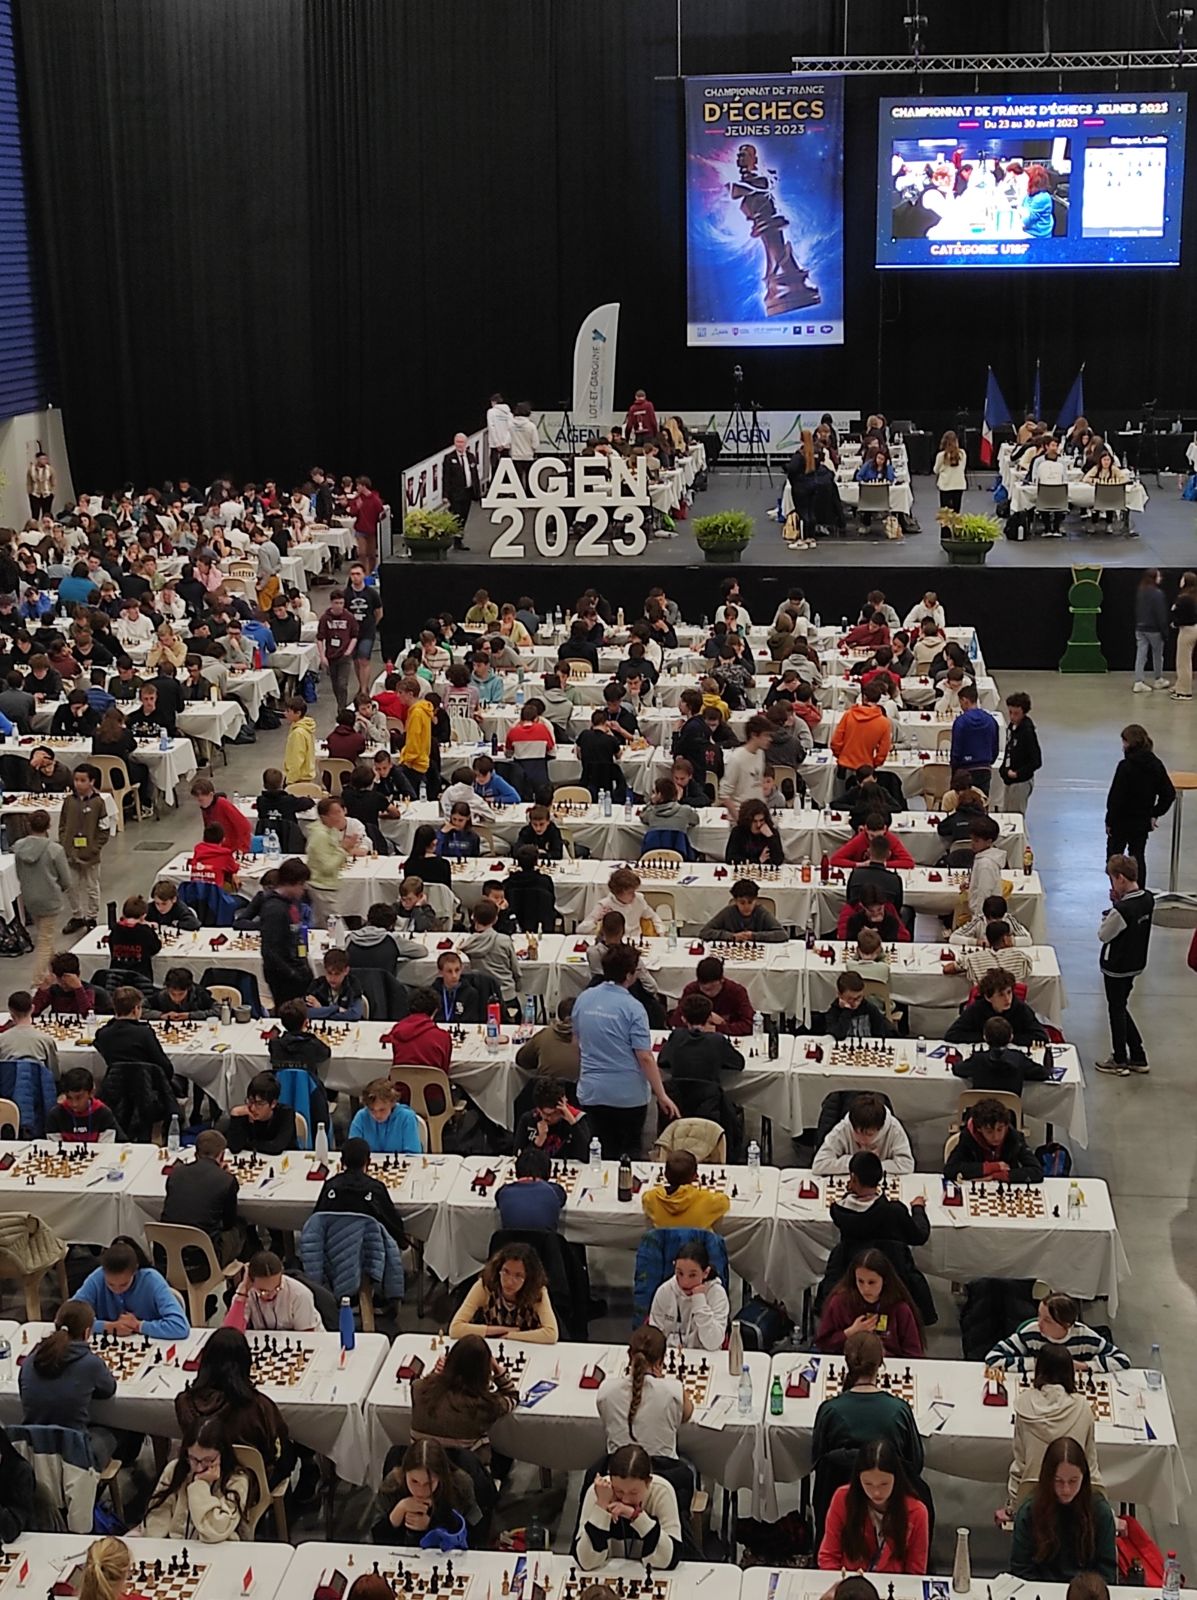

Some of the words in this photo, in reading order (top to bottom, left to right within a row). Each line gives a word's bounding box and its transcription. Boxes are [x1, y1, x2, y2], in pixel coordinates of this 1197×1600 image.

[704, 87, 770, 97] CHAMPIONNAT
[772, 86, 785, 95] DE
[786, 85, 825, 95] FRANCE
[704, 96, 824, 122] D'ÉCHECS
[892, 106, 972, 118] CHAMPIONNAT
[974, 107, 991, 117] DE
[991, 104, 1037, 116] FRANCE
[725, 125, 771, 136] JEUNES
[774, 124, 805, 135] 2023
[984, 120, 997, 129] Du
[998, 120, 1010, 129] 23
[1024, 119, 1035, 128] 30
[1036, 119, 1055, 128] avril
[1056, 119, 1078, 128] 2023
[555, 429, 600, 443] AGEN
[725, 429, 770, 443] AGEN
[486, 456, 649, 501] AGEN
[489, 506, 648, 558] 2023
